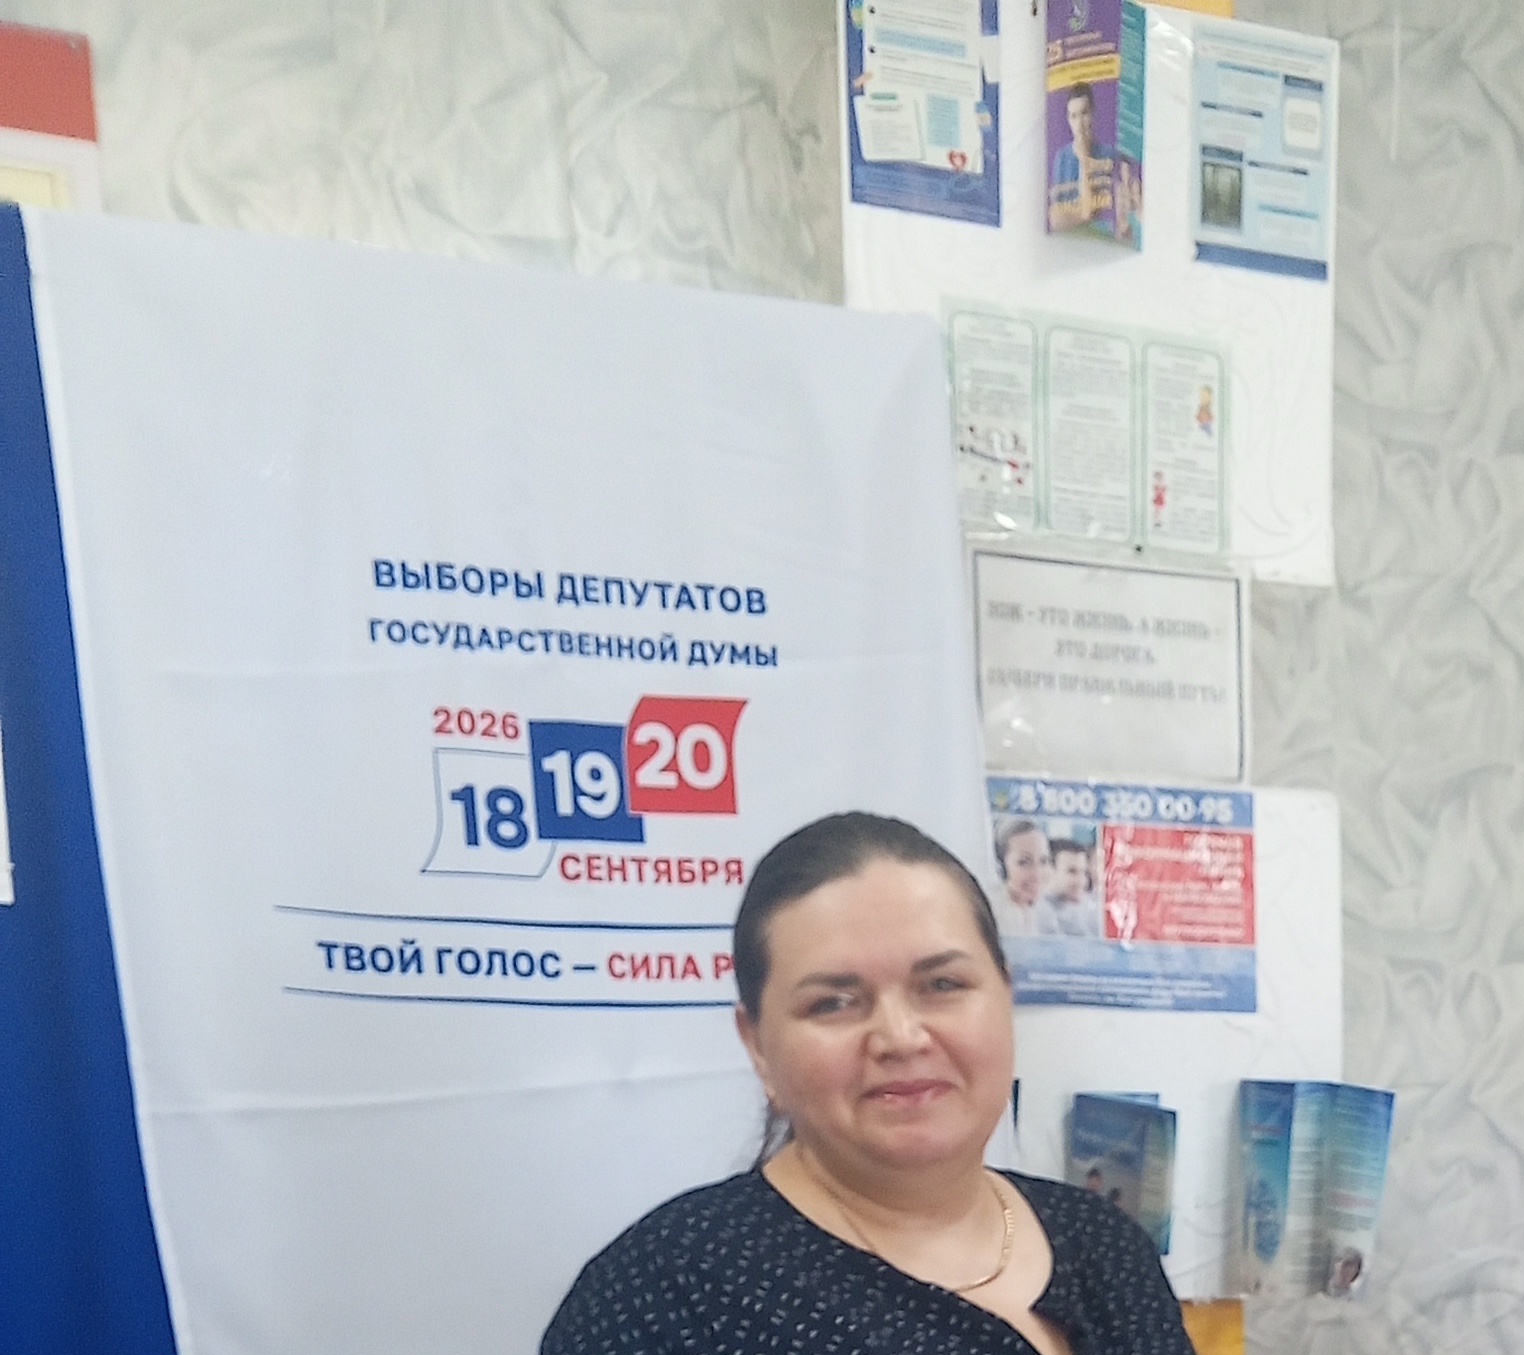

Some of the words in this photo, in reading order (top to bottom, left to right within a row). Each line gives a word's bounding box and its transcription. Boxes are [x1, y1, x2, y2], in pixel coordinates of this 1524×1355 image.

[372, 559, 545, 600] ВЫБОРЫ
[556, 572, 768, 615] ДЕПУТАТОВ
[369, 617, 679, 663] ГОСУДАРСТВЕННОЙ
[688, 641, 778, 667] ДУМЫ
[432, 708, 520, 740] 2026
[450, 783, 529, 849] 18
[540, 749, 622, 819] 19
[632, 720, 730, 790] 20
[559, 852, 745, 885] СЕНТЯБРЯ
[316, 939, 424, 975] ТВОЙ
[435, 948, 561, 979] ГОЛОС
[607, 953, 701, 980] СИЛА
